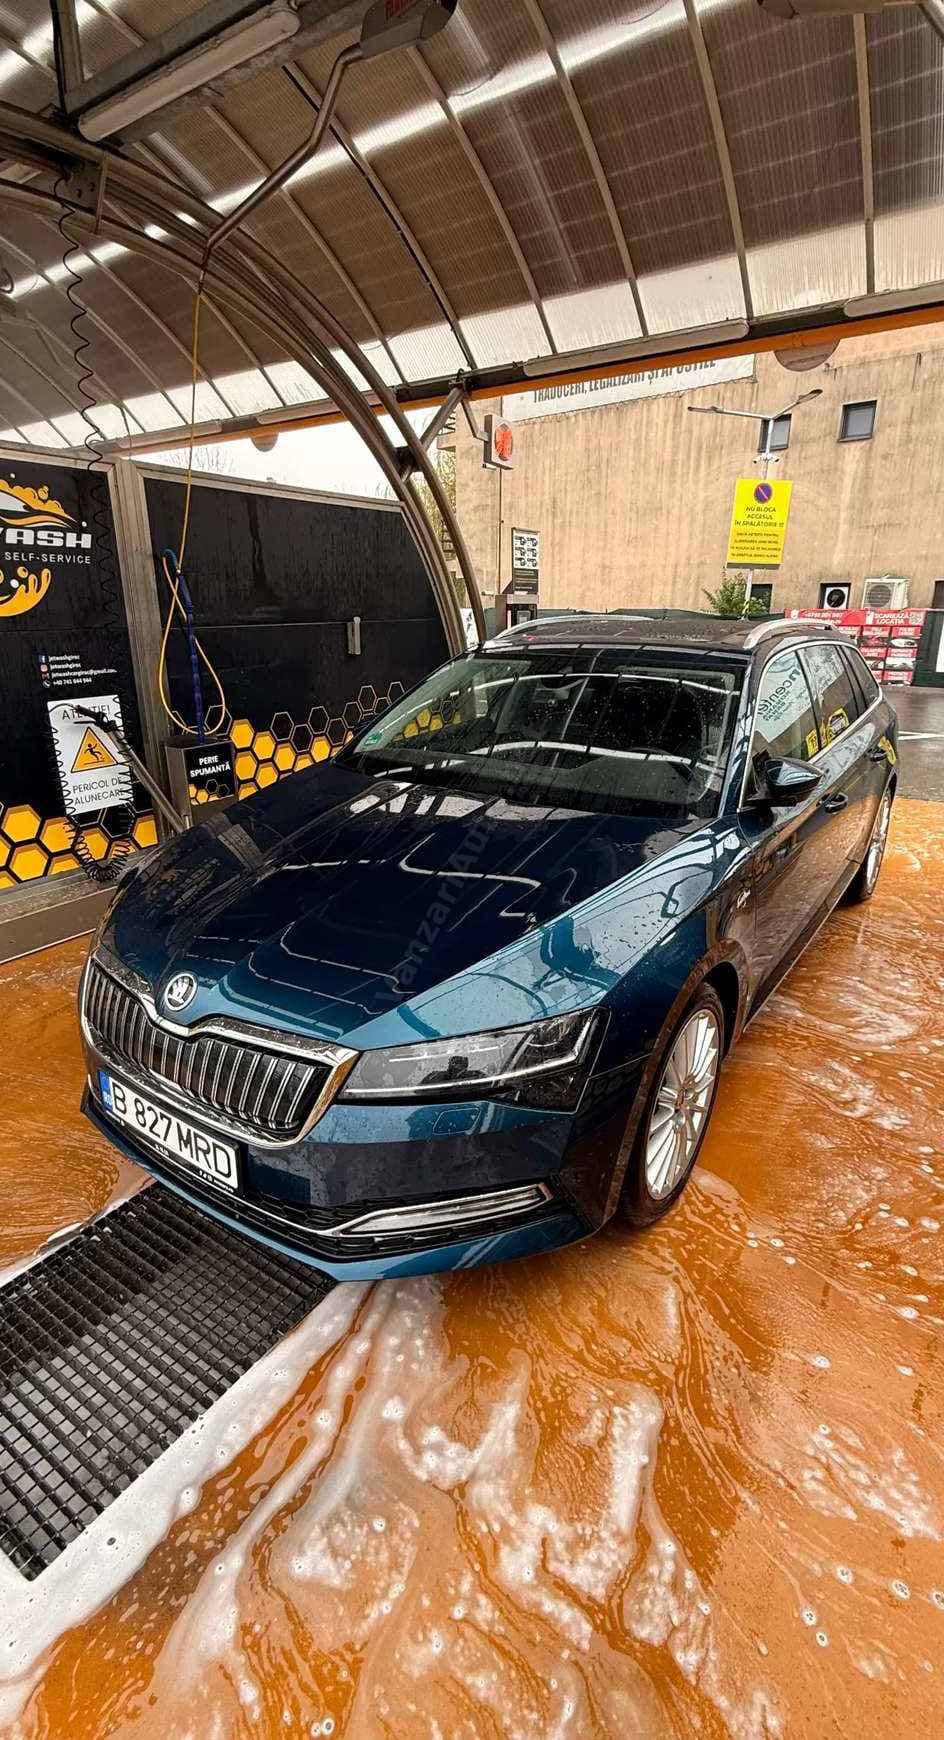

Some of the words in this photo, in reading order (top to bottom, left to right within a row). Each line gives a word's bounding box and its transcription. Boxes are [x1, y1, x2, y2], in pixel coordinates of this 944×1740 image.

[0, 527, 92, 549] ASH
[4, 551, 92, 565] SELF-SERVICE
[199, 755, 218, 766] PERIE
[72, 780, 109, 794] PERICOL
[112, 1081, 127, 1115] B
[134, 1097, 173, 1142] 827
[176, 1121, 232, 1179] MRD
